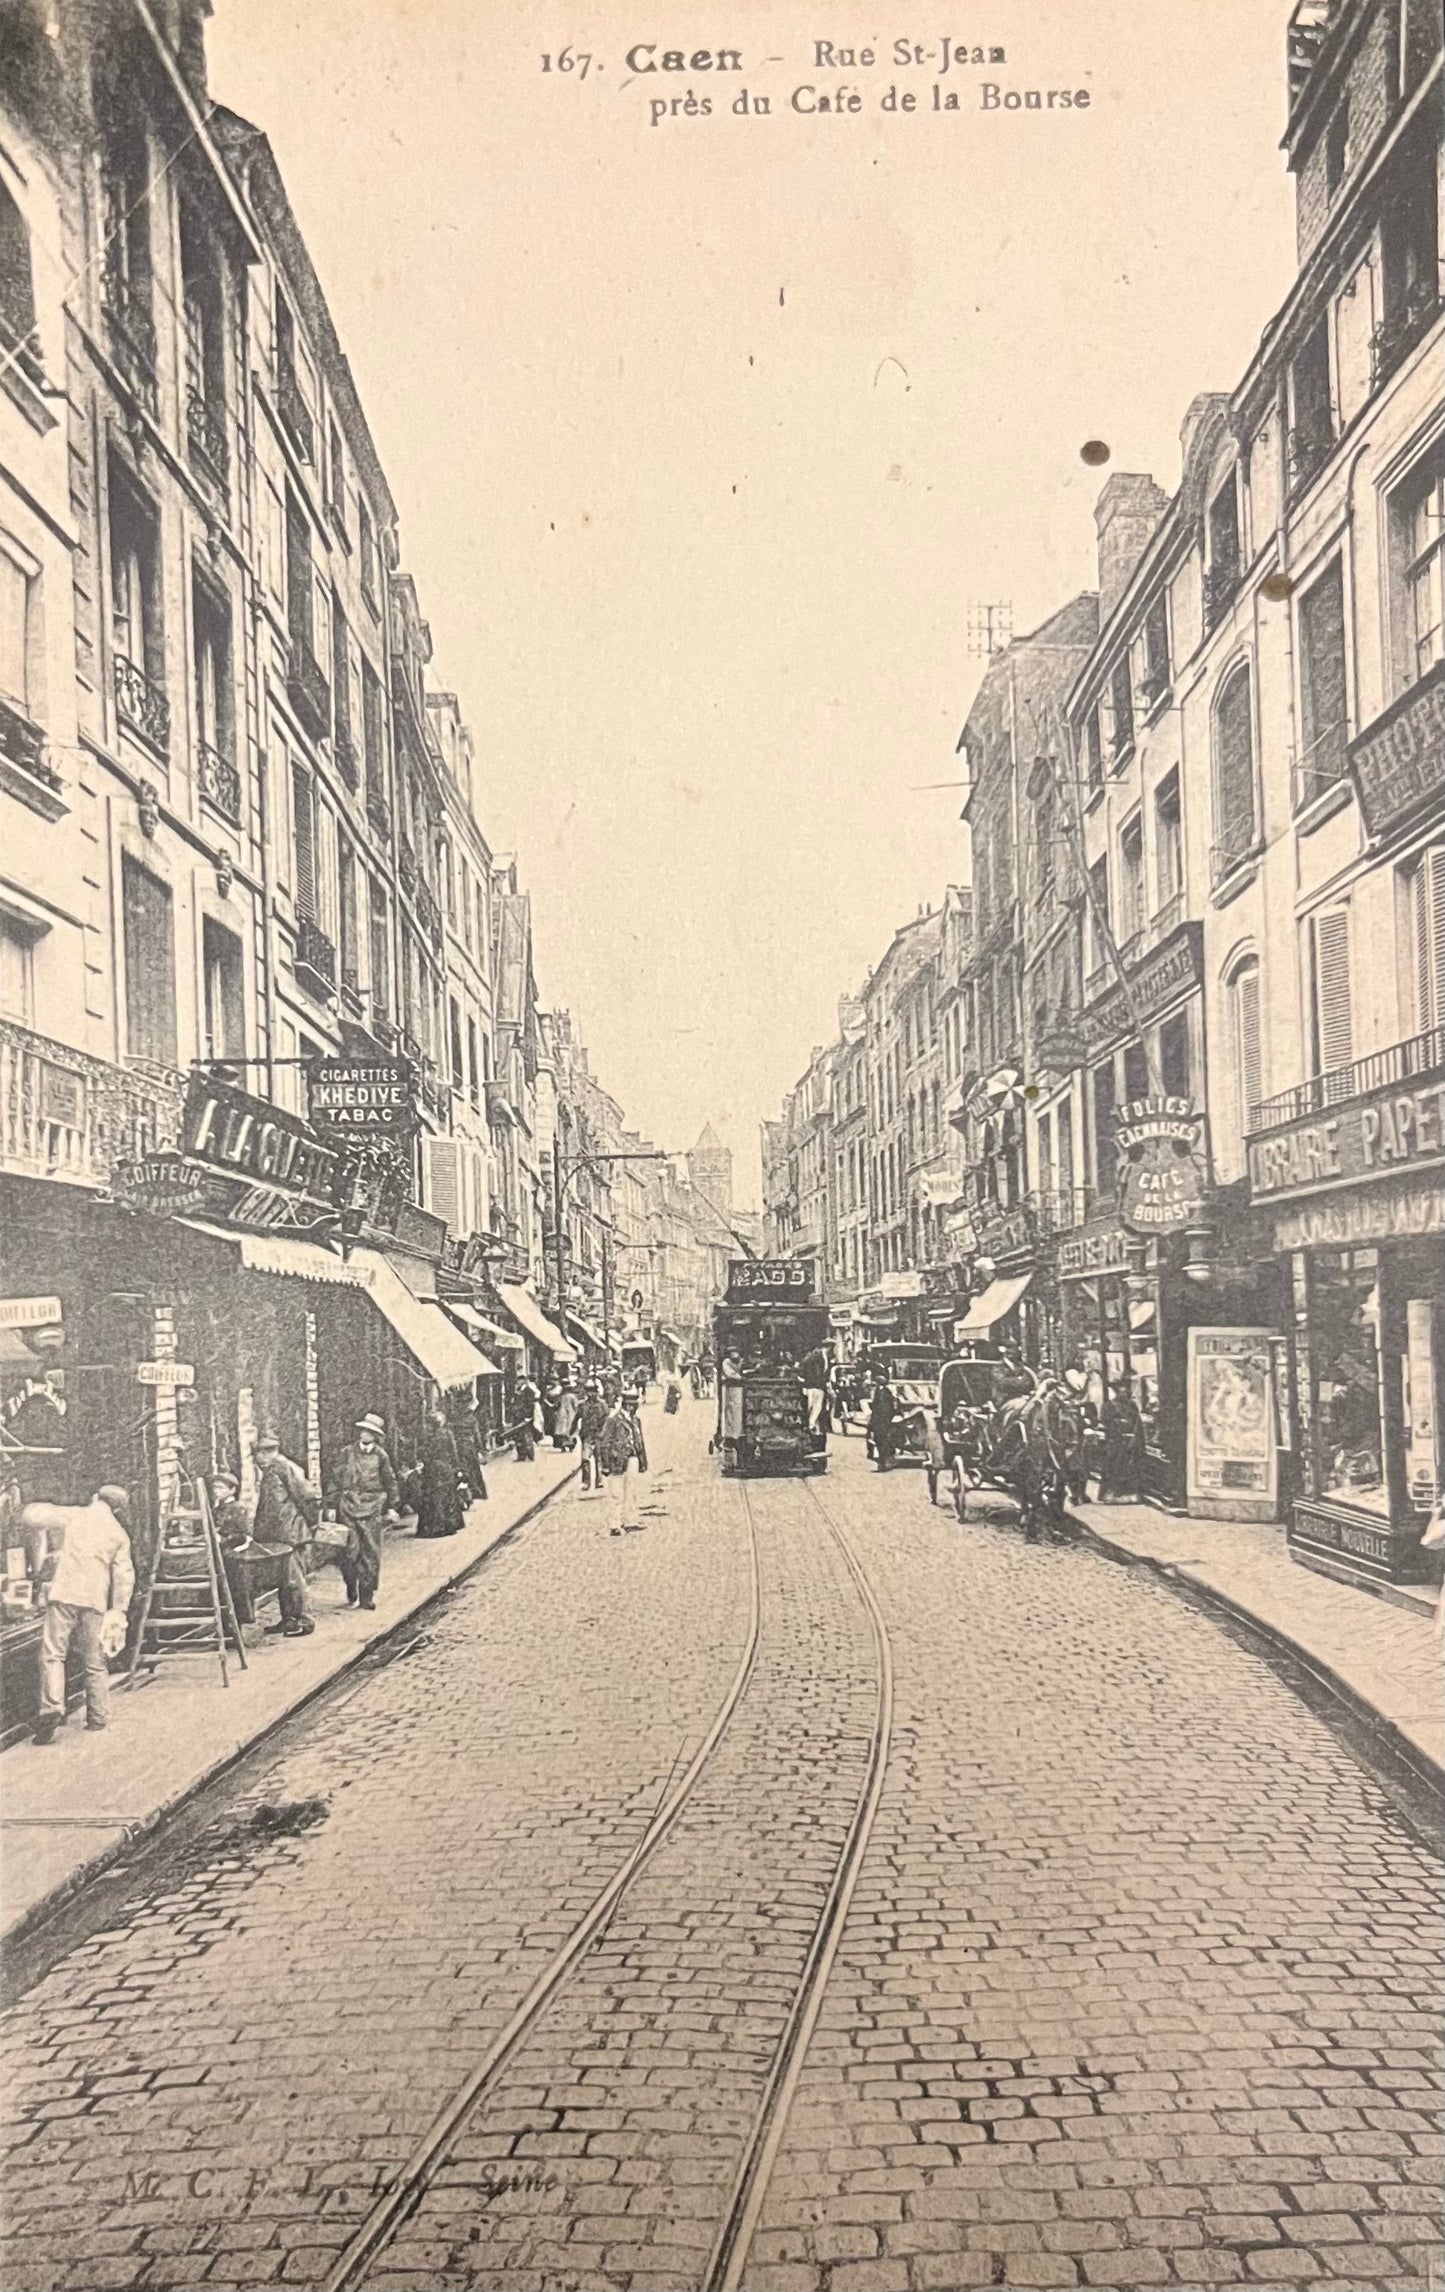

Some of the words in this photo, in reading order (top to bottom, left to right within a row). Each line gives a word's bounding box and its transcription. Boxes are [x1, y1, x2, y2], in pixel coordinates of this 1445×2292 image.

[320, 1068, 398, 1082] CIGARETTES
[320, 1086, 402, 1104] KHEDIVE
[327, 1108, 393, 1122] TABAC
[123, 1162, 203, 1188] COIFFEUR
